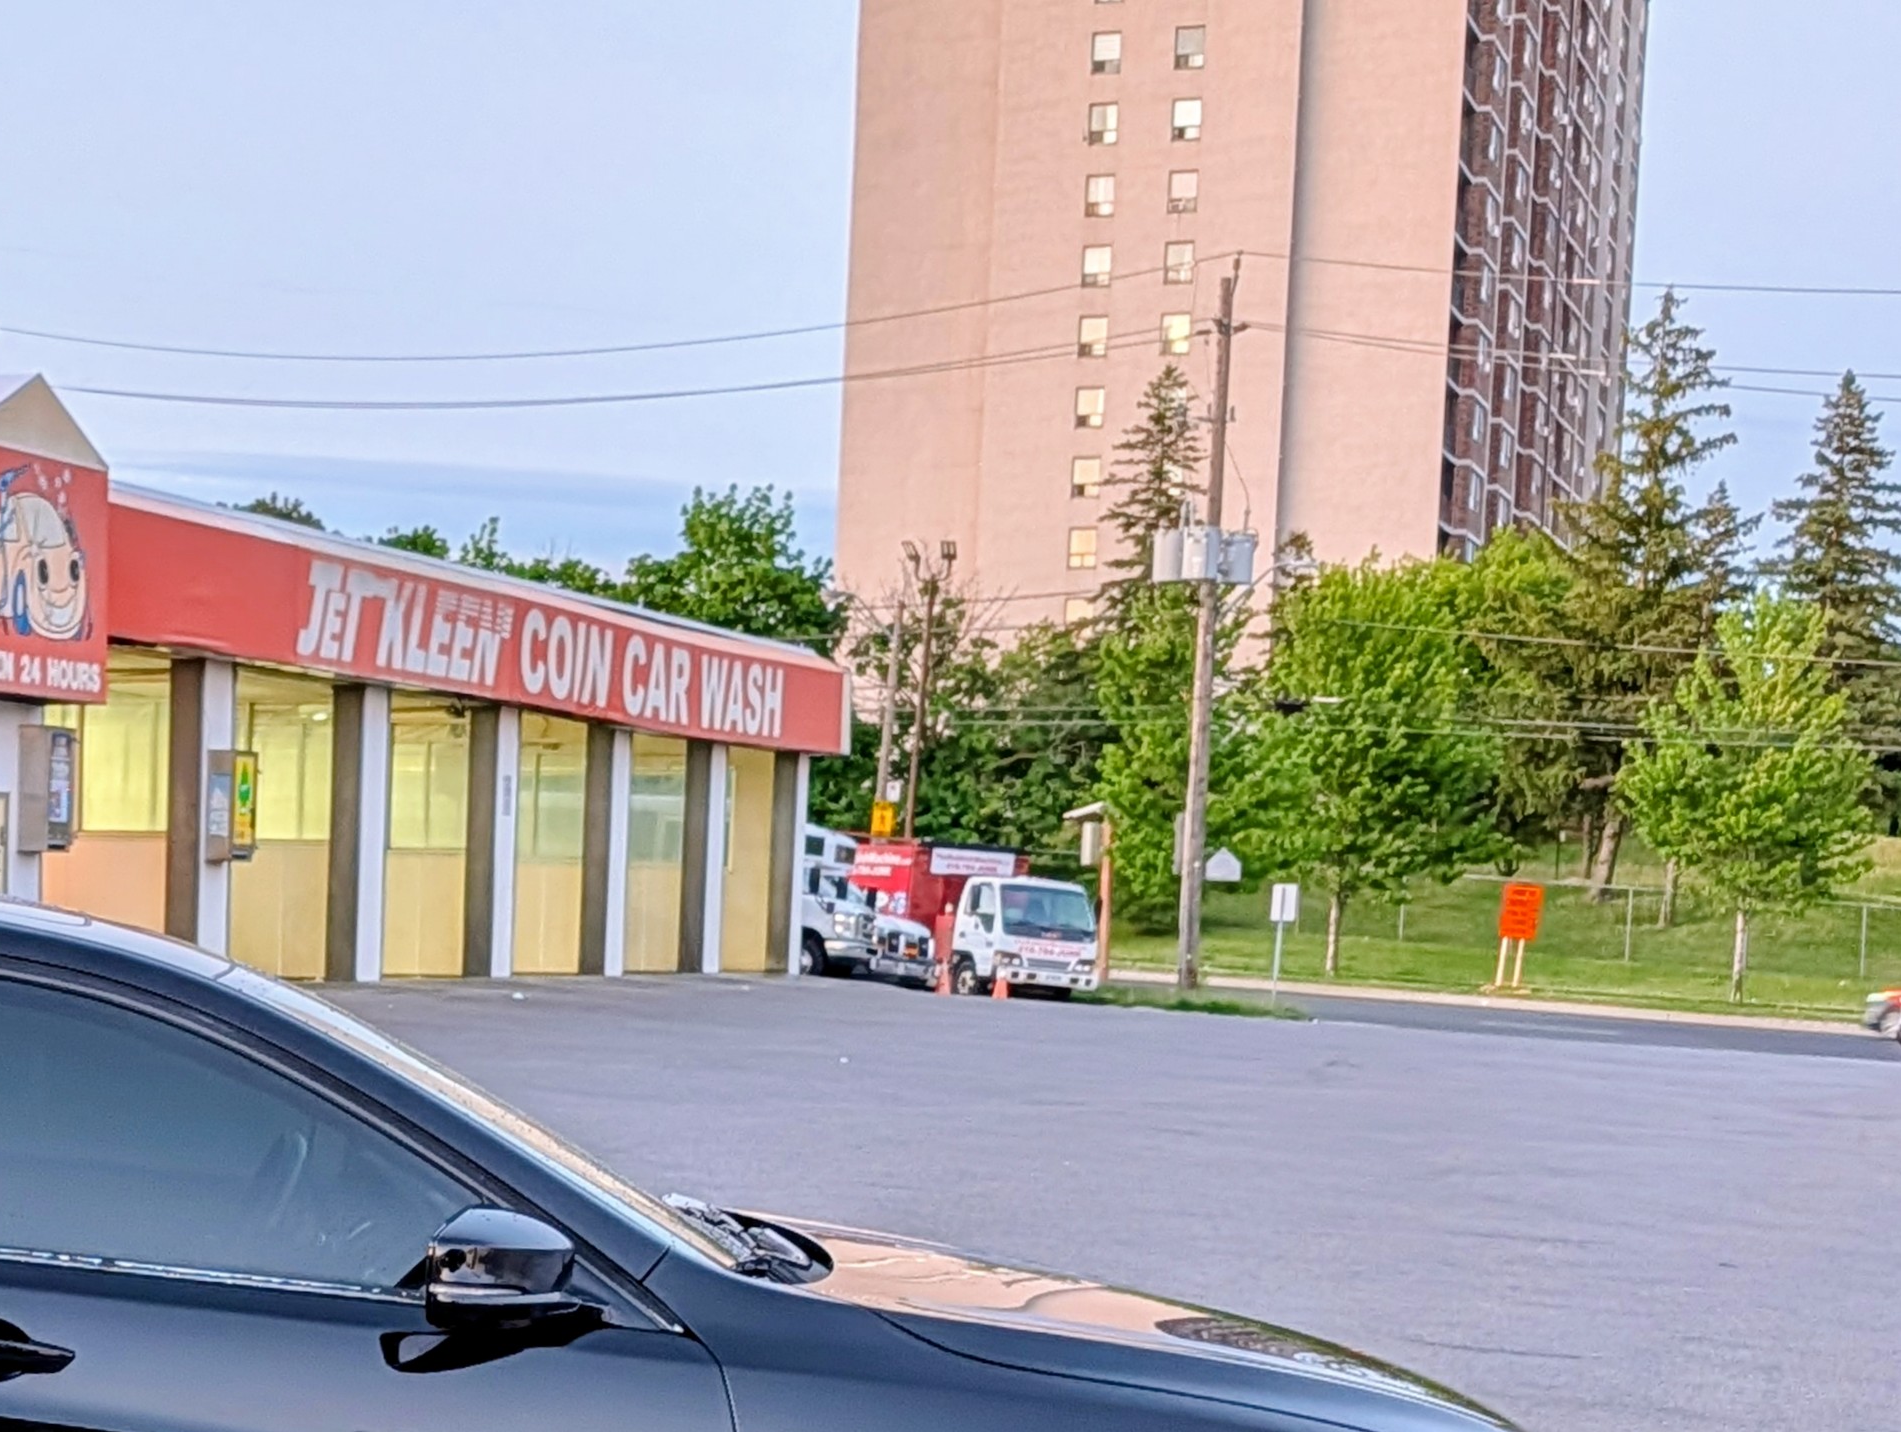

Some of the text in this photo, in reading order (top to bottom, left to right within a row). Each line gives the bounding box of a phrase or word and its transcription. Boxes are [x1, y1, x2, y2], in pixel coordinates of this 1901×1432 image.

[19, 654, 42, 686] 24
[46, 656, 101, 693] HOURS
[296, 559, 784, 739] JET KLEEN COIN CAR WASH
